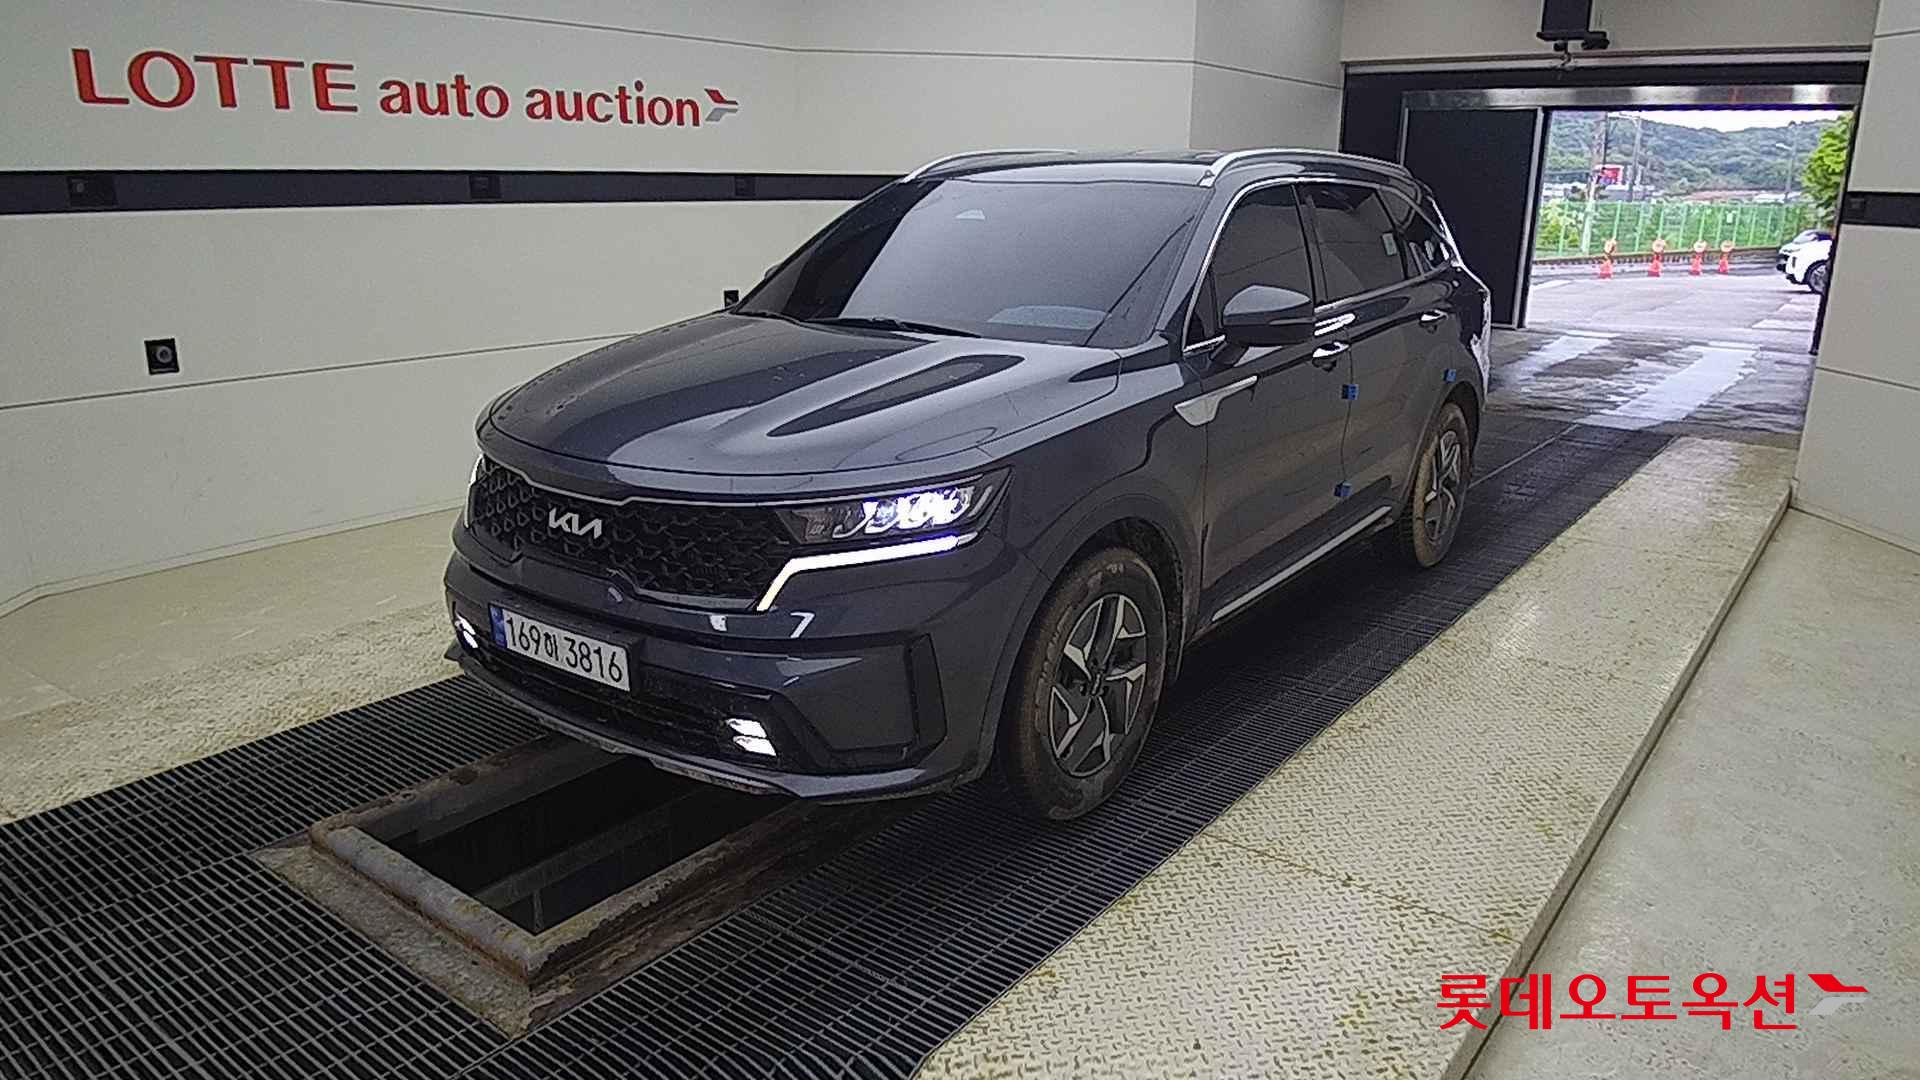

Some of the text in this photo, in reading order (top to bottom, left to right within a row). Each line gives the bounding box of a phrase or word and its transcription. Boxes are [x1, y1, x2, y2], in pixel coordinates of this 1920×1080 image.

[72, 48, 701, 127] LOTTE auto auction
[548, 507, 602, 540] KIA
